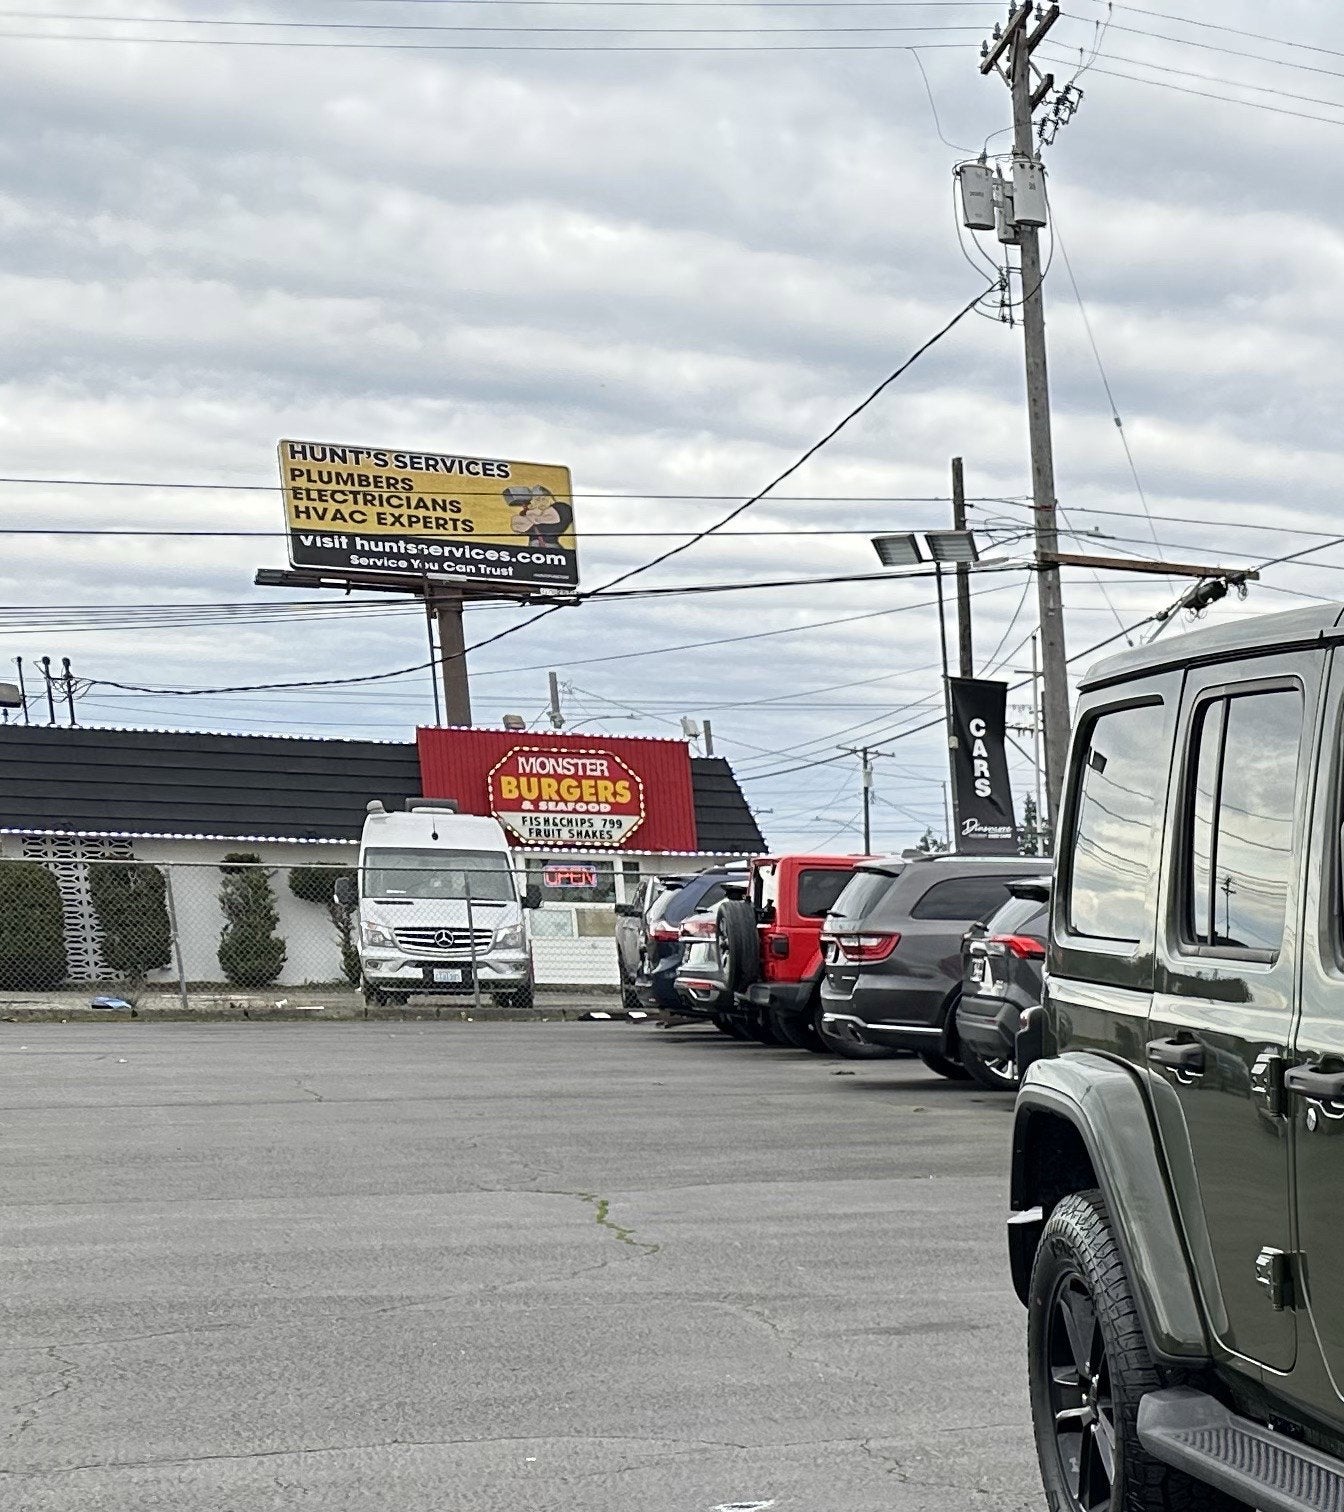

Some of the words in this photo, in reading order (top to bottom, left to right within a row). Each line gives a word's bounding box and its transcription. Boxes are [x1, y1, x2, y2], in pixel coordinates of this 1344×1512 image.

[289, 444, 389, 468] HUNT'S
[394, 454, 510, 479] SERVICES
[290, 467, 414, 491] PLUMBERS
[292, 487, 461, 514] ELECTRICIANS
[294, 505, 368, 524] HVAC
[376, 512, 475, 532] EXPERTS
[350, 555, 408, 568] Service
[443, 562, 475, 574] Can
[478, 564, 513, 576] Trust
[517, 756, 609, 777] MONSTER
[969, 718, 992, 797] CARS
[500, 775, 632, 804] BURGERS
[521, 800, 534, 811] &
[539, 801, 612, 812] SEAFOOD
[521, 816, 594, 828] FISH&CHIPS
[602, 818, 623, 829] 799
[528, 827, 563, 838] FRUIT
[568, 829, 613, 840] SHAKES
[546, 866, 594, 886] OPEN
